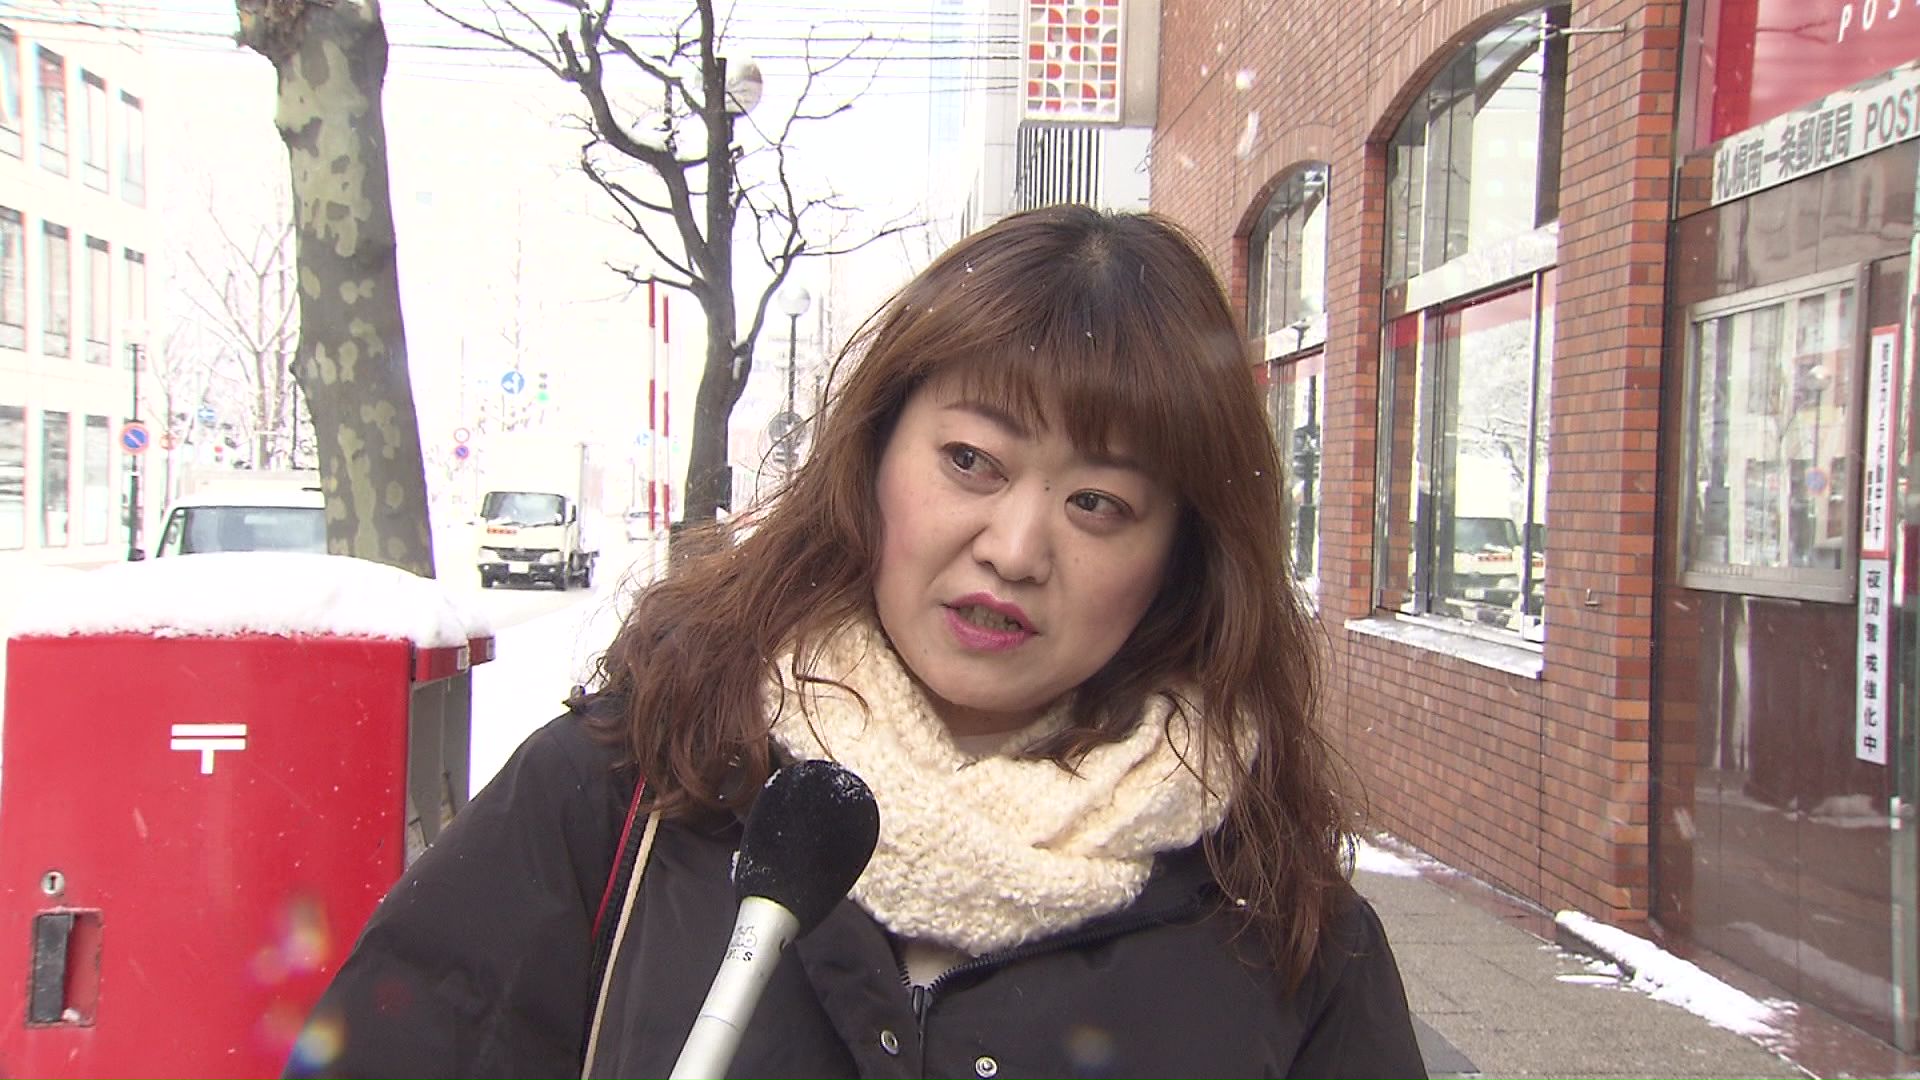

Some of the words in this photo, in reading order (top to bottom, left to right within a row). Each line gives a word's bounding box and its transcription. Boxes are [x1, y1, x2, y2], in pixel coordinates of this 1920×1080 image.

[1717, 102, 1853, 200] 札幌南一条郵便局
